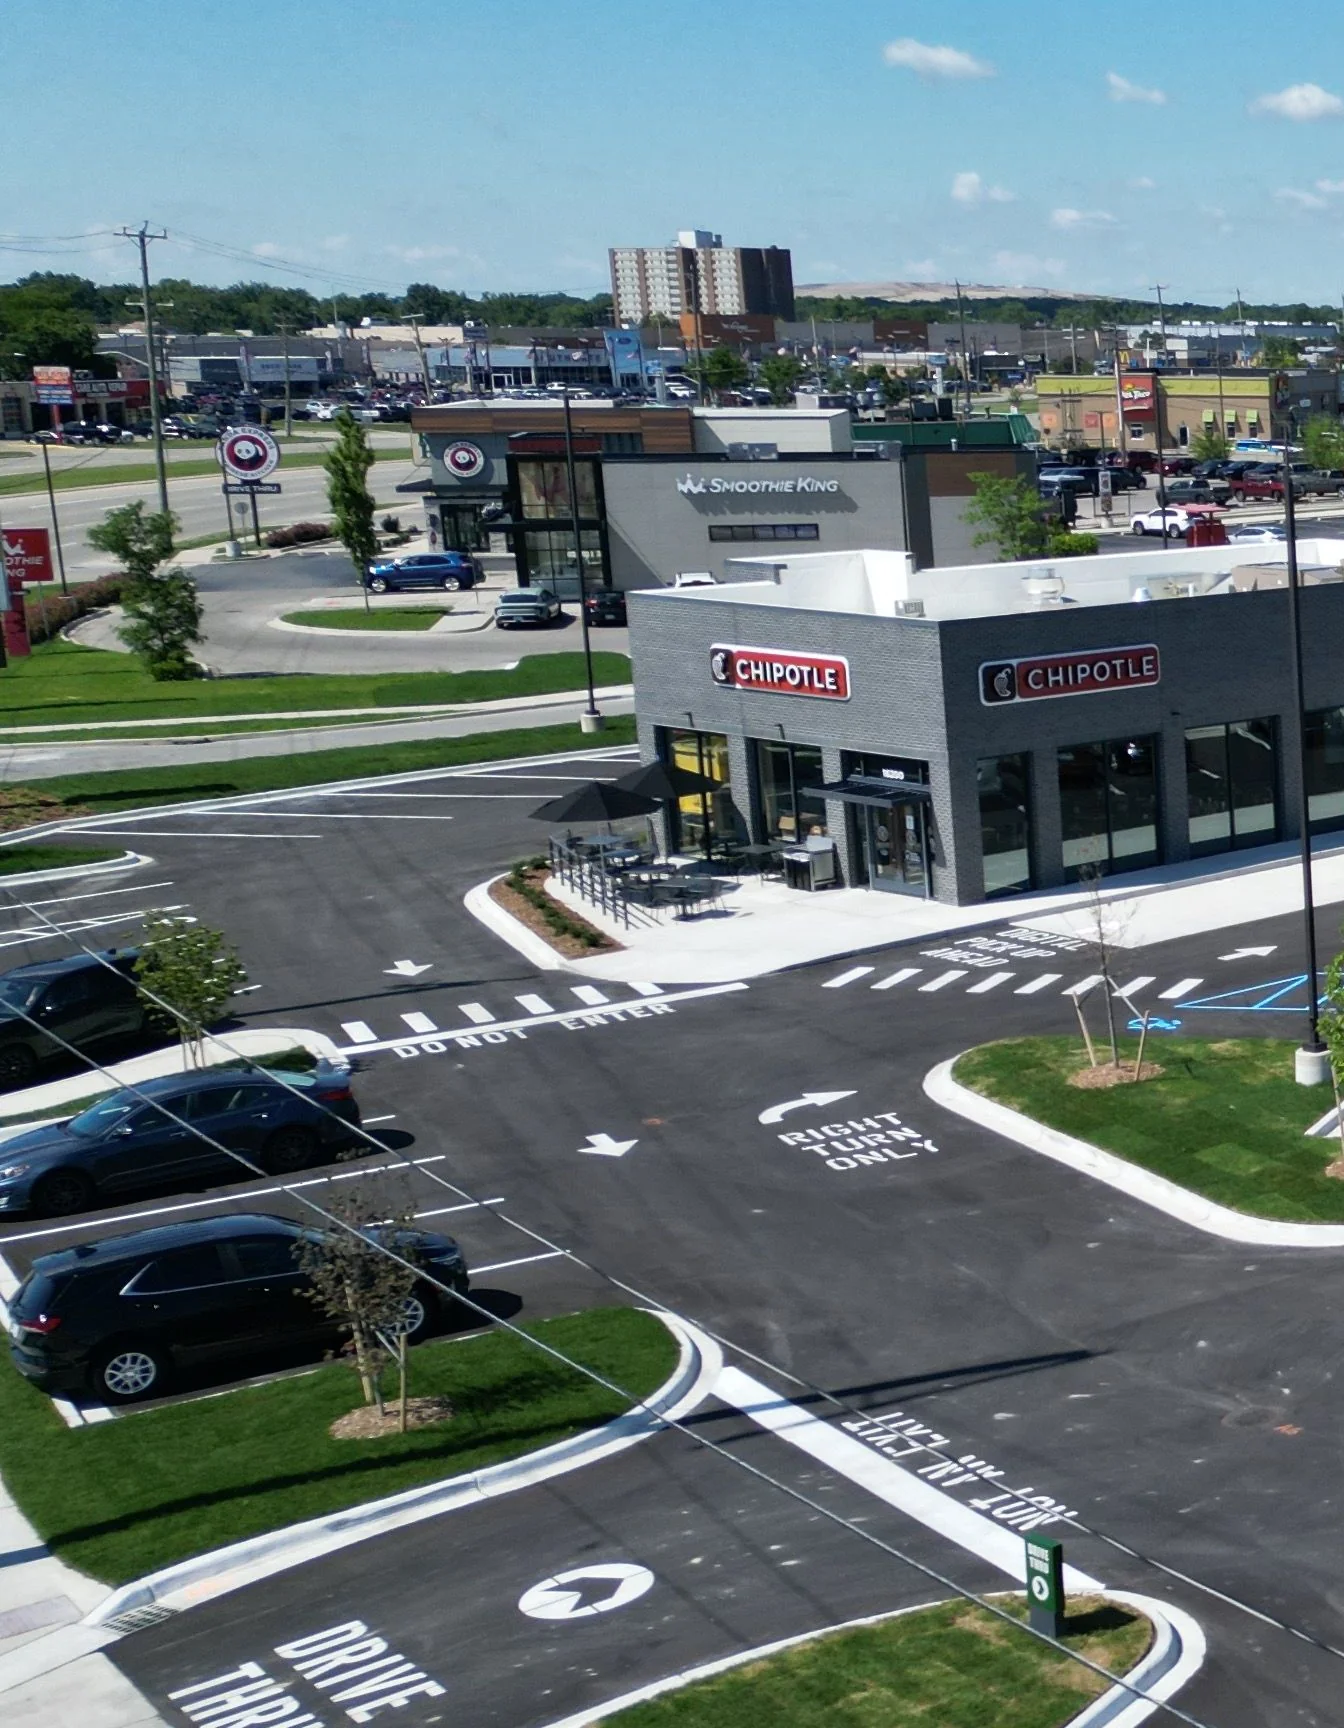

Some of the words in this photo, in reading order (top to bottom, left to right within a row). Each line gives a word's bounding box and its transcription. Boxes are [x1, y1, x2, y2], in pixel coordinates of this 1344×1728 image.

[797, 477, 839, 493] KING
[736, 659, 838, 690] CHIPOTLE
[1028, 656, 1156, 690] CHIPOTLE
[954, 936, 1025, 952] PICK
[1009, 948, 1057, 958] UP
[996, 928, 1089, 951] DIGITAL
[919, 947, 1010, 967] AHEAD
[392, 1041, 448, 1060] DO
[456, 1027, 529, 1049] NOT
[558, 1002, 678, 1031] ENTER
[777, 1112, 902, 1146] RIGHT
[801, 1127, 923, 1157] TURN
[825, 1139, 939, 1171] ONLY
[1027, 1542, 1050, 1562] DRIVE
[1029, 1556, 1050, 1575] THRU
[272, 1620, 448, 1724] DRIVE
